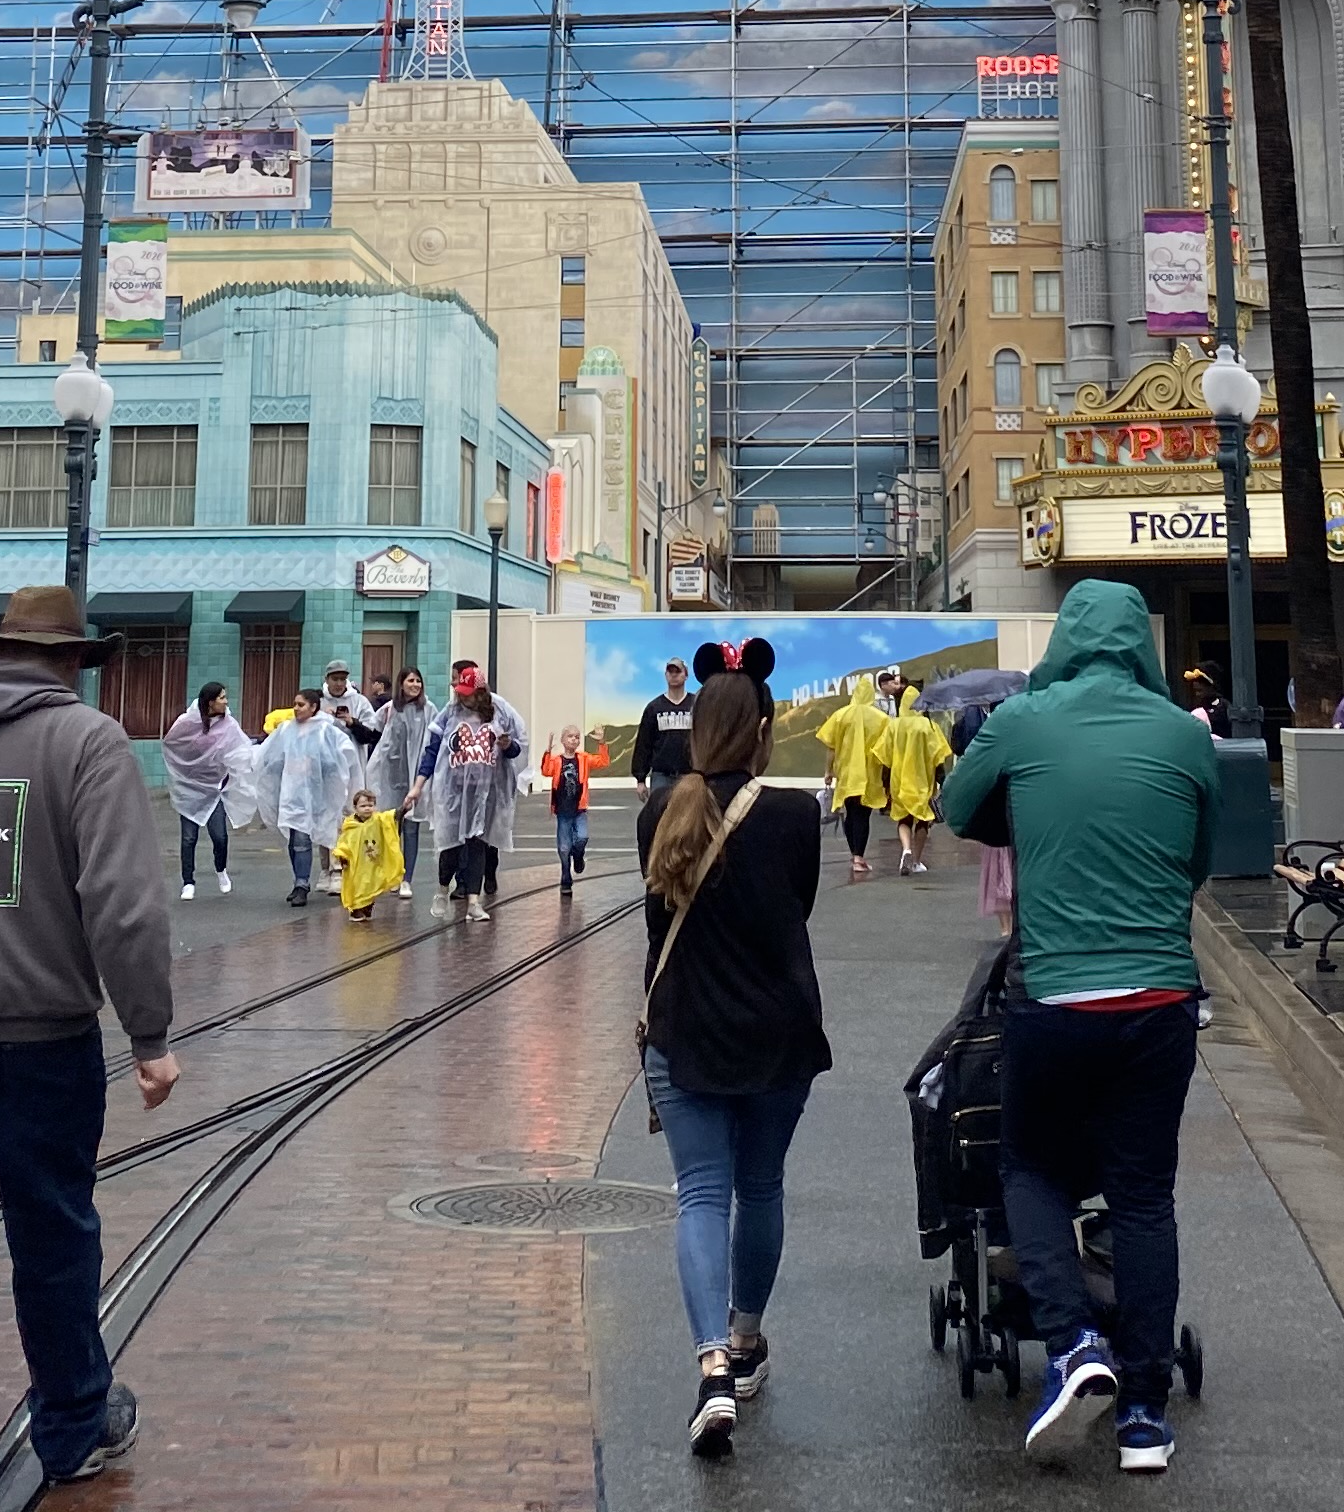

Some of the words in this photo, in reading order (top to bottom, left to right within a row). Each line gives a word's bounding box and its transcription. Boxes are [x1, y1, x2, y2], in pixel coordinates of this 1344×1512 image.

[976, 55, 1059, 77] ROOSE
[1007, 80, 1058, 100] HOT
[109, 281, 134, 289] FOOD
[140, 281, 163, 289] WINE
[1148, 273, 1174, 281] FOOD
[1180, 273, 1203, 281] WINE
[693, 351, 706, 363] EL
[694, 366, 706, 472] CAPITAN
[603, 388, 626, 513] CREST
[1063, 421, 1281, 465] HYPERO
[1129, 510, 1252, 544] FROZE
[366, 564, 427, 588] Beverly
